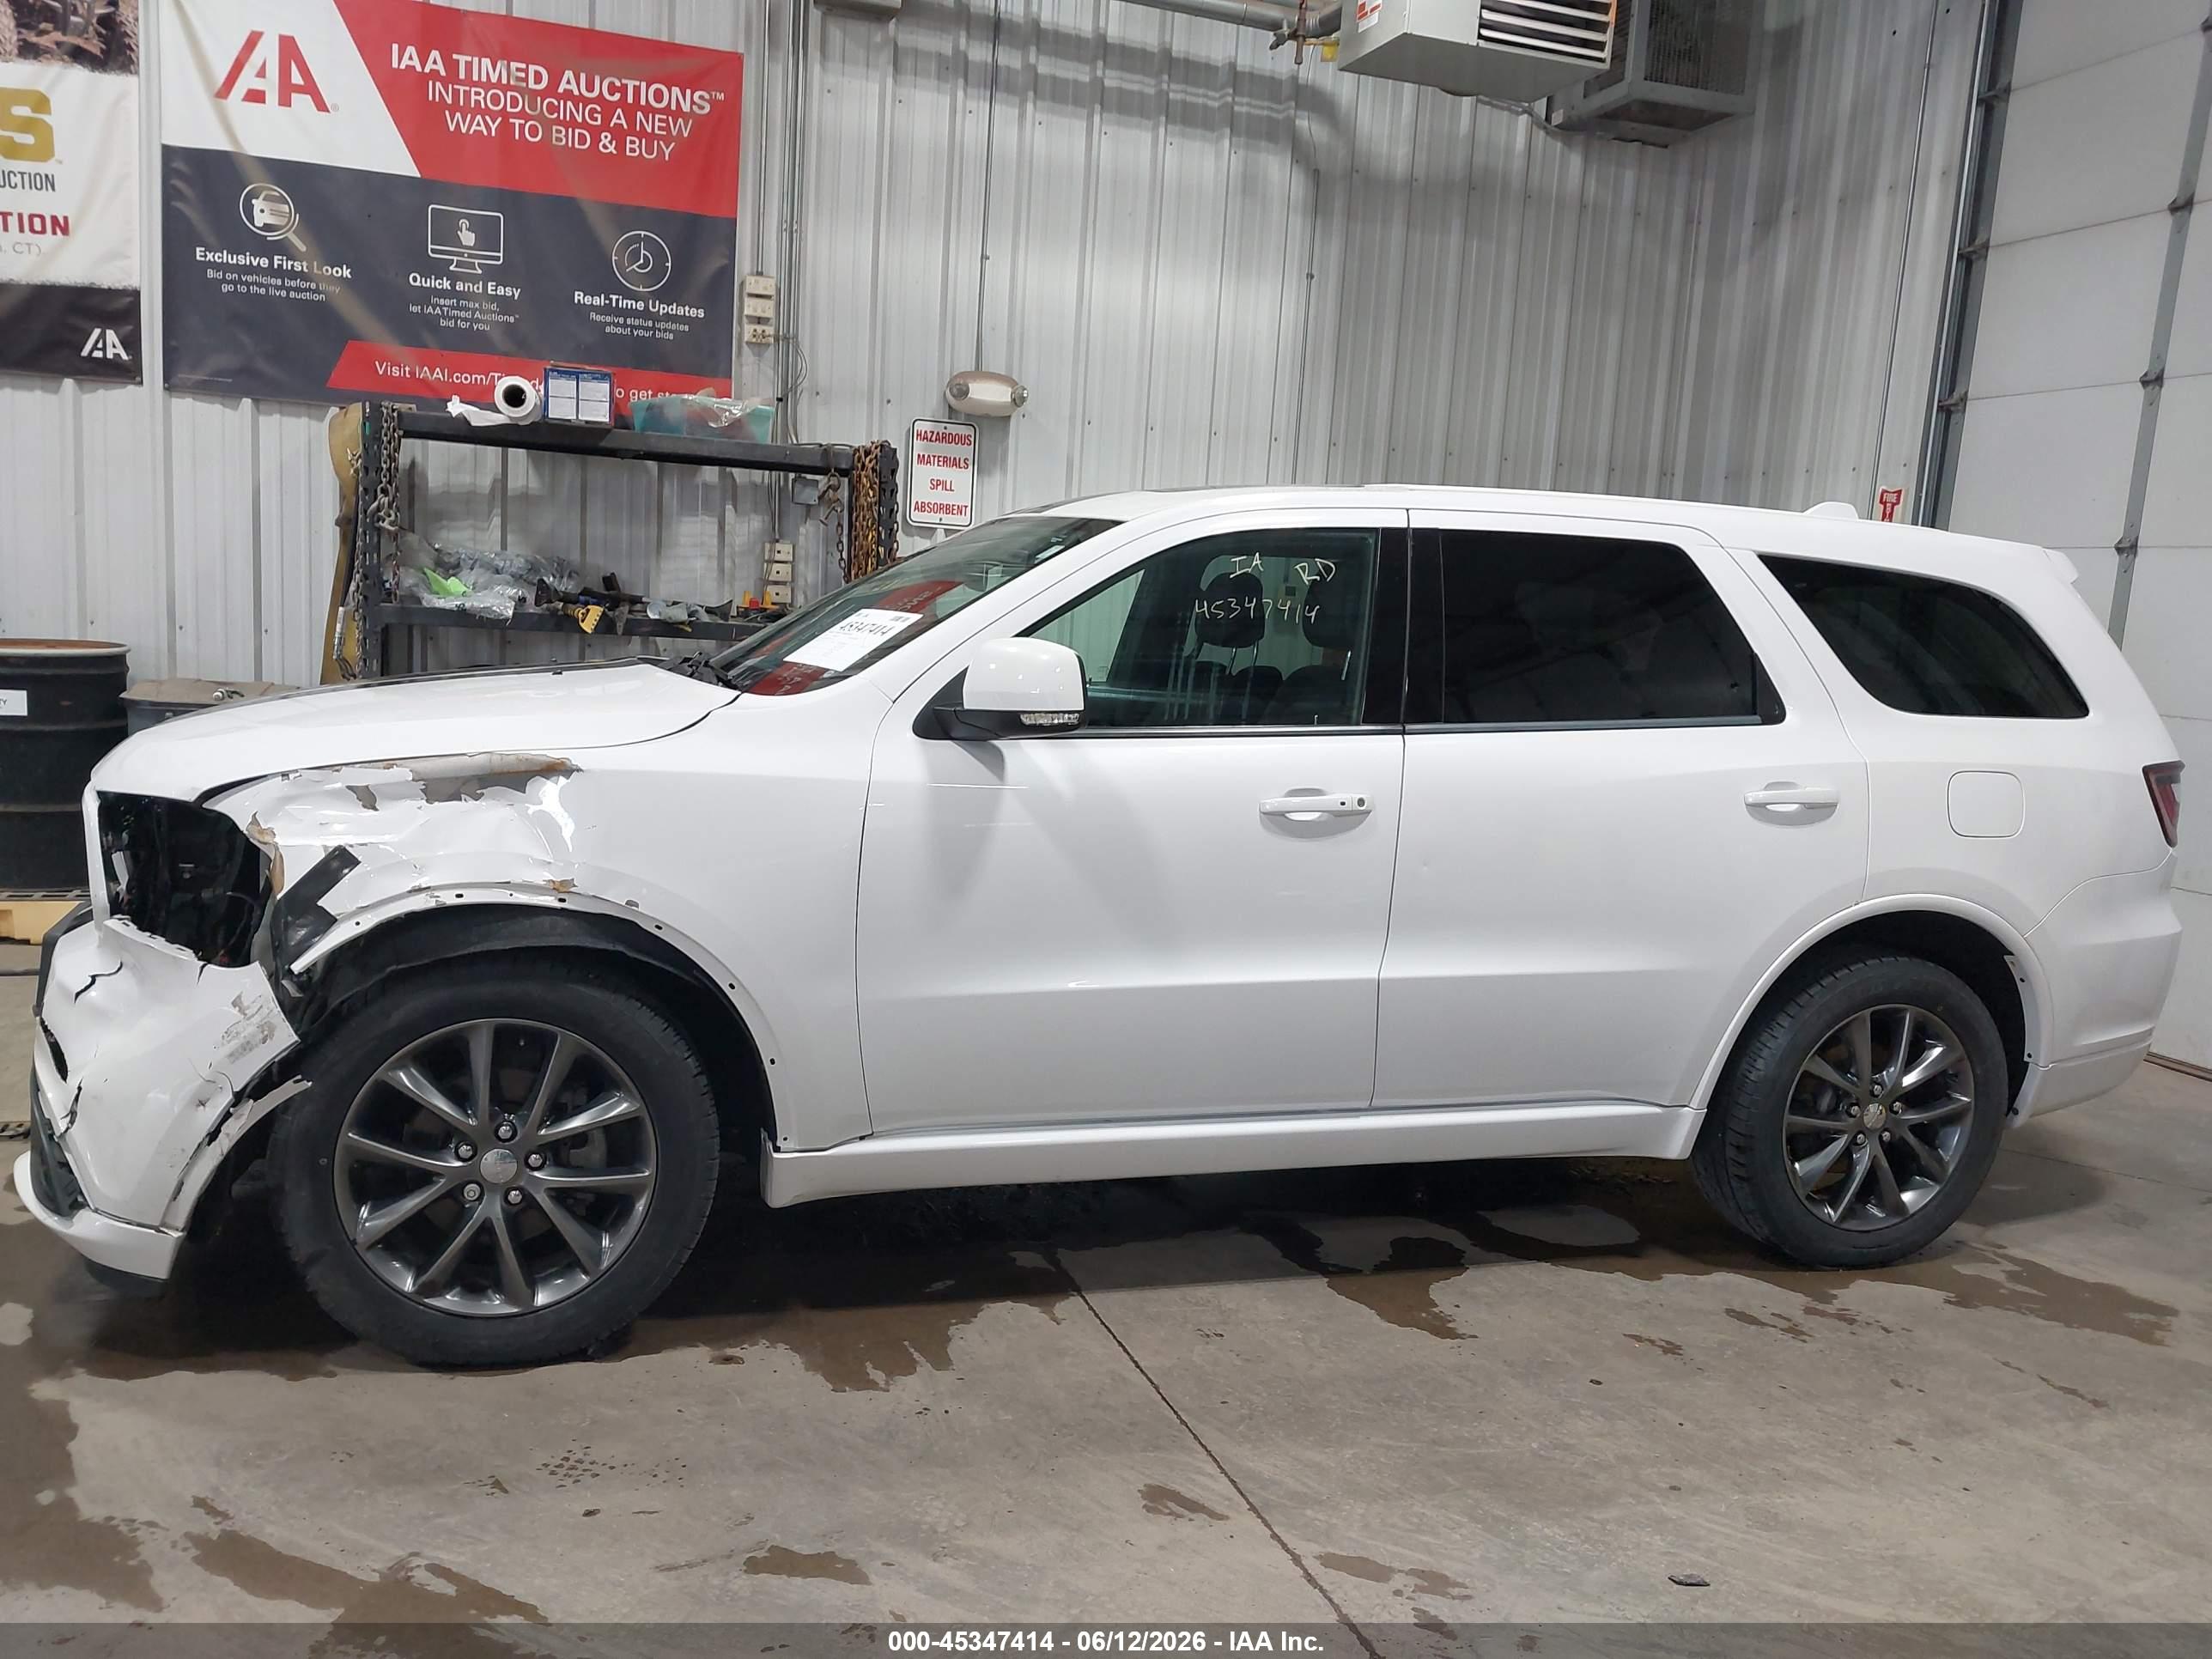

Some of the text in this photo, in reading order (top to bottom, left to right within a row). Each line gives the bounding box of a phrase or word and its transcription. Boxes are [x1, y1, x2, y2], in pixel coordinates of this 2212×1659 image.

[391, 43, 446, 76] IAA
[453, 53, 548, 89] TIMED
[428, 80, 693, 137] INTRODUCING A NEW
[445, 110, 676, 161] WAY TO BID & BUY
[195, 246, 352, 278] Exclusive First Look
[207, 269, 222, 280] Bid
[226, 272, 238, 282] on
[241, 274, 283, 286] vehicles
[284, 277, 317, 290] before
[409, 272, 521, 300] Quick and Easy
[222, 283, 326, 301] go to the live auction
[410, 303, 422, 313] let
[430, 295, 500, 312] Insert max bid,
[574, 291, 705, 319] Real-Time Updates
[440, 318, 490, 331] bid for you
[590, 312, 690, 332] Receive status updates
[605, 325, 674, 340] about your bids
[374, 361, 410, 379] Visit
[629, 386, 653, 402] get
[916, 429, 973, 447] HAZARDOUS
[917, 453, 969, 470] MATERIALS
[929, 478, 955, 492] SPILL
[914, 501, 969, 517] ABSORBENT
[1230, 551, 1336, 586] IA RD
[1195, 596, 1321, 624] 45347414
